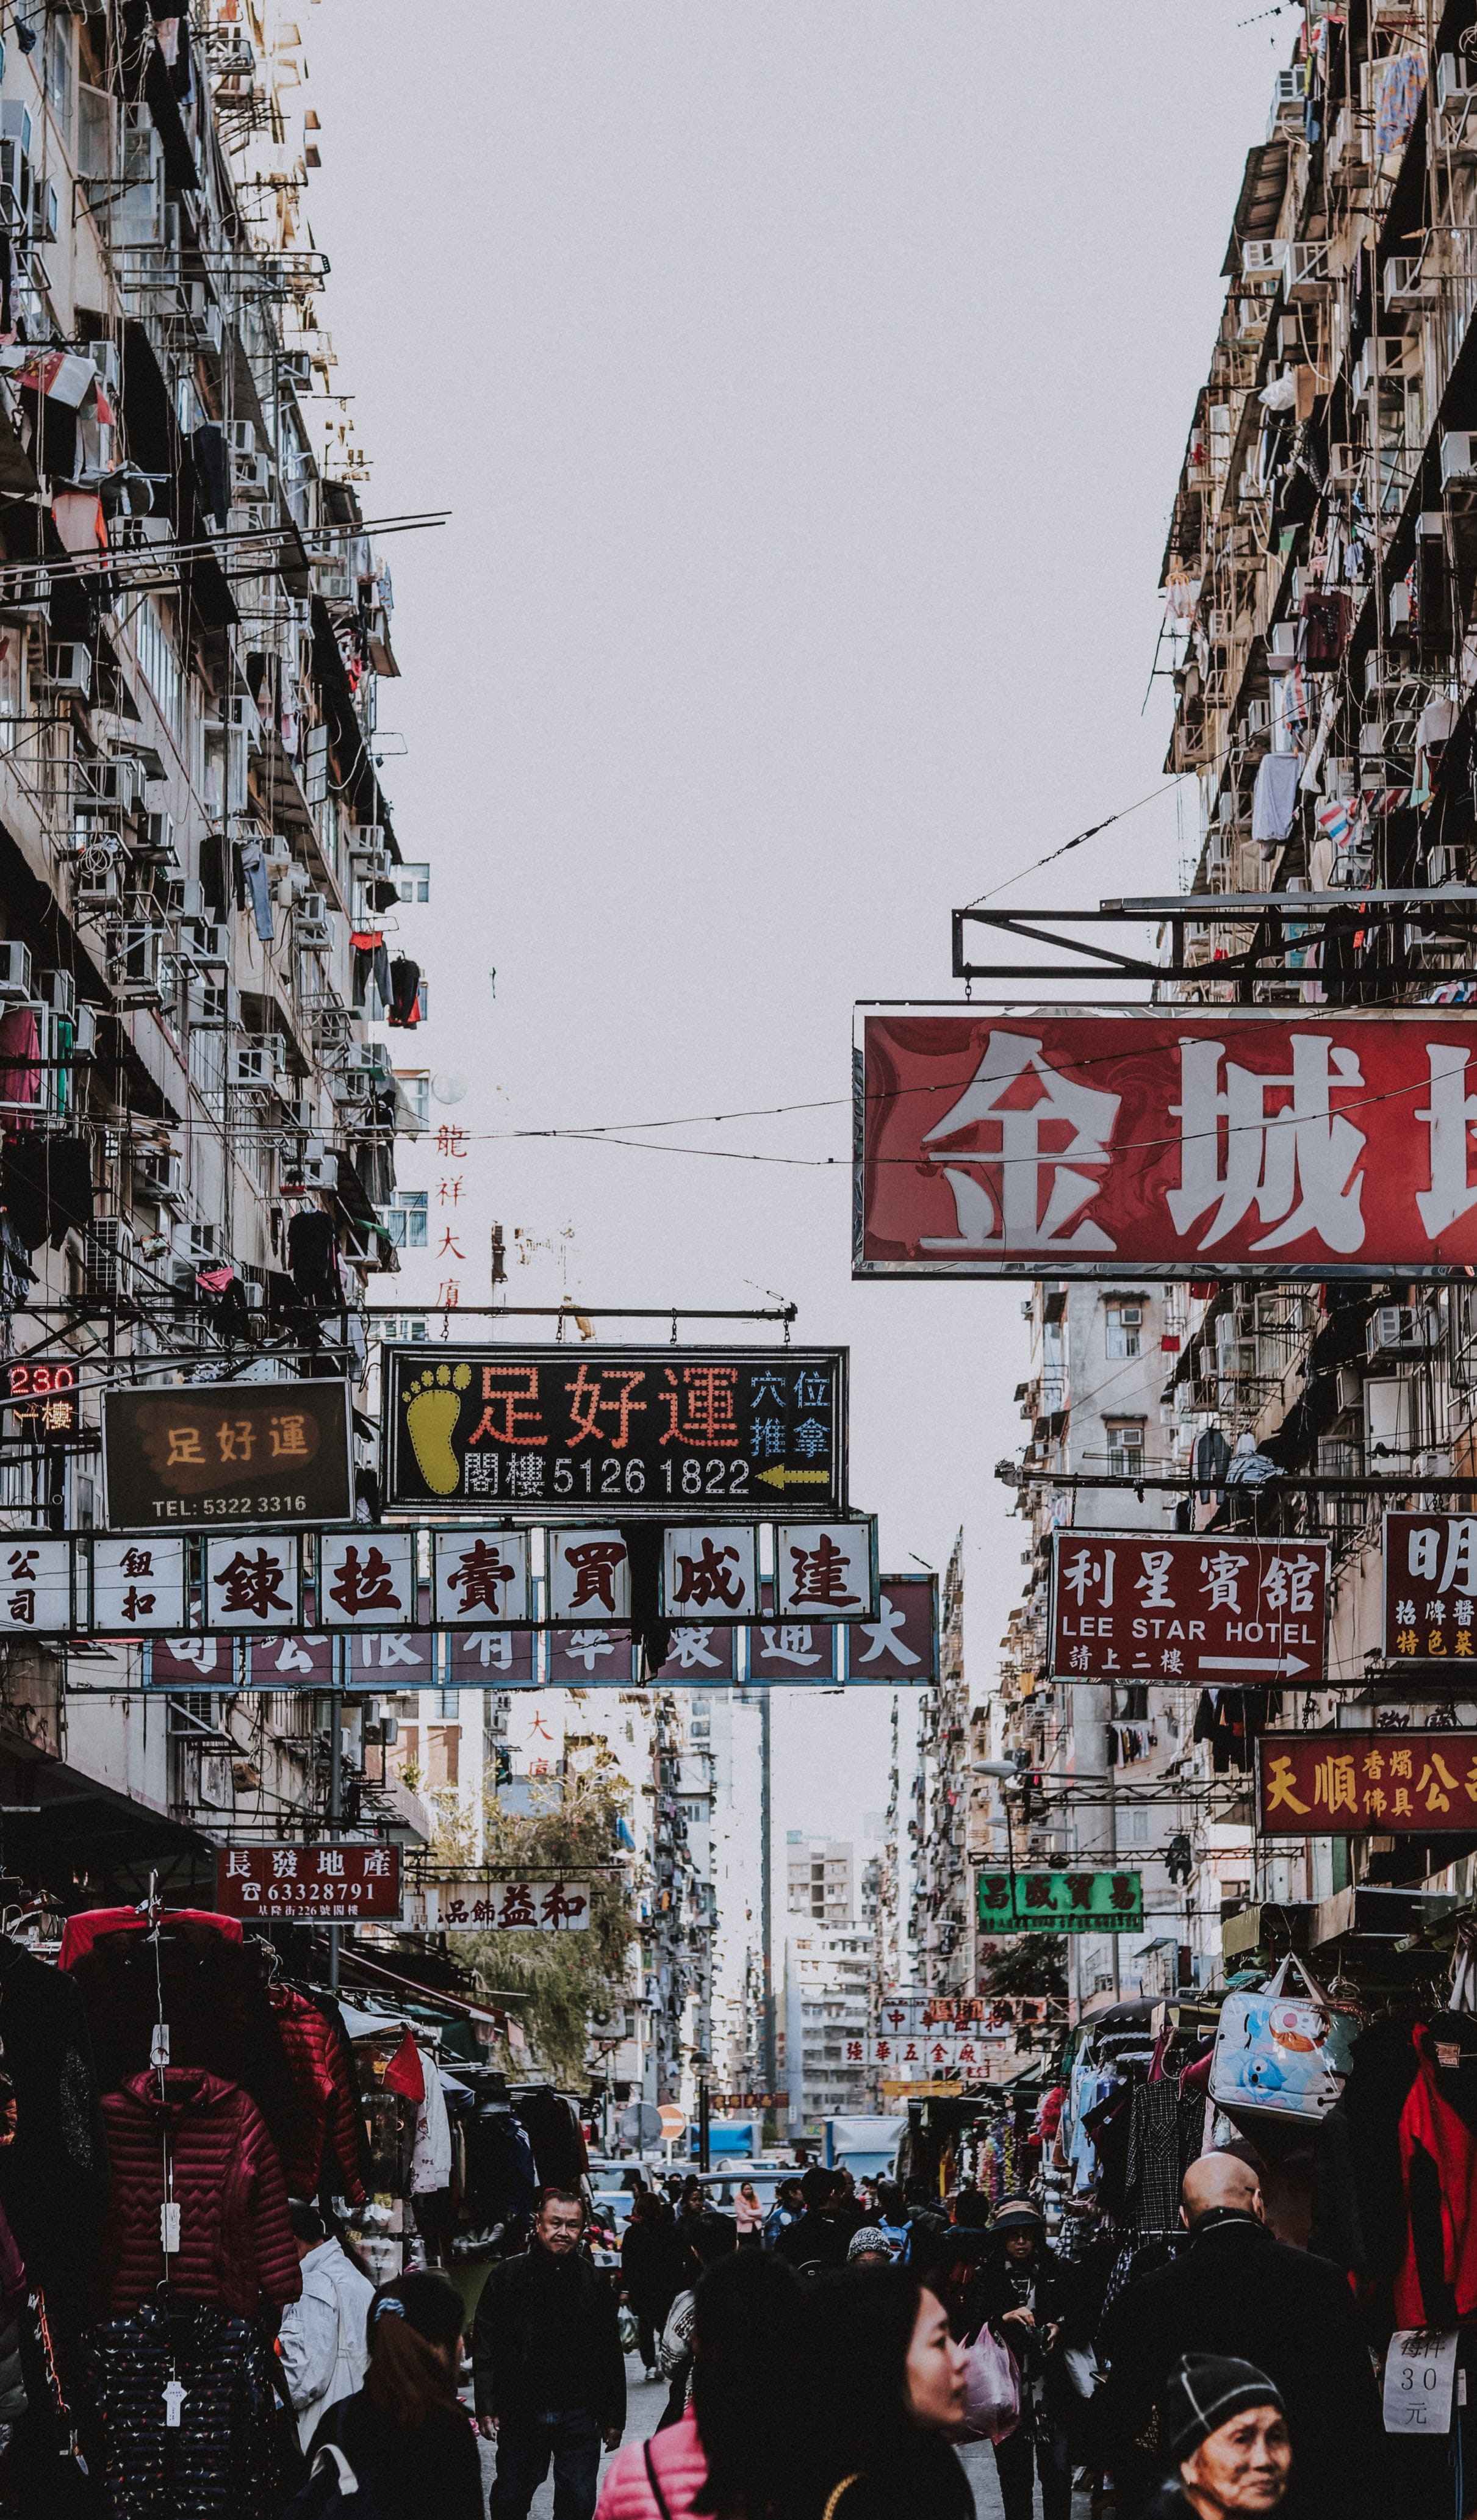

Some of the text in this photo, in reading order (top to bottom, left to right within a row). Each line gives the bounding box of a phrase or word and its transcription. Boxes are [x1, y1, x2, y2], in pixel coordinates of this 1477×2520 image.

[434, 1124, 467, 1308] 龍祥大廈
[11, 1367, 73, 1394] 230
[750, 1370, 830, 1408] 穴位
[21, 1400, 73, 1430] 一樓
[467, 1364, 739, 1449] 足好運
[167, 1415, 308, 1466] 足好運
[750, 1417, 830, 1458] 推拿
[465, 1452, 750, 1497] 閣樓 5126 1822
[153, 1496, 306, 1517] TEL: 5322 3316
[1063, 1616, 1317, 1644] LEE STAR HOTEL
[1396, 1630, 1475, 1657] 特色菜
[1069, 1644, 1185, 1674] 請上二樓
[226, 1849, 391, 1878] 長發地產
[267, 1882, 375, 1900] 63328791
[1401, 2367, 1437, 2391] 30
[1406, 2402, 1427, 2425] 元
